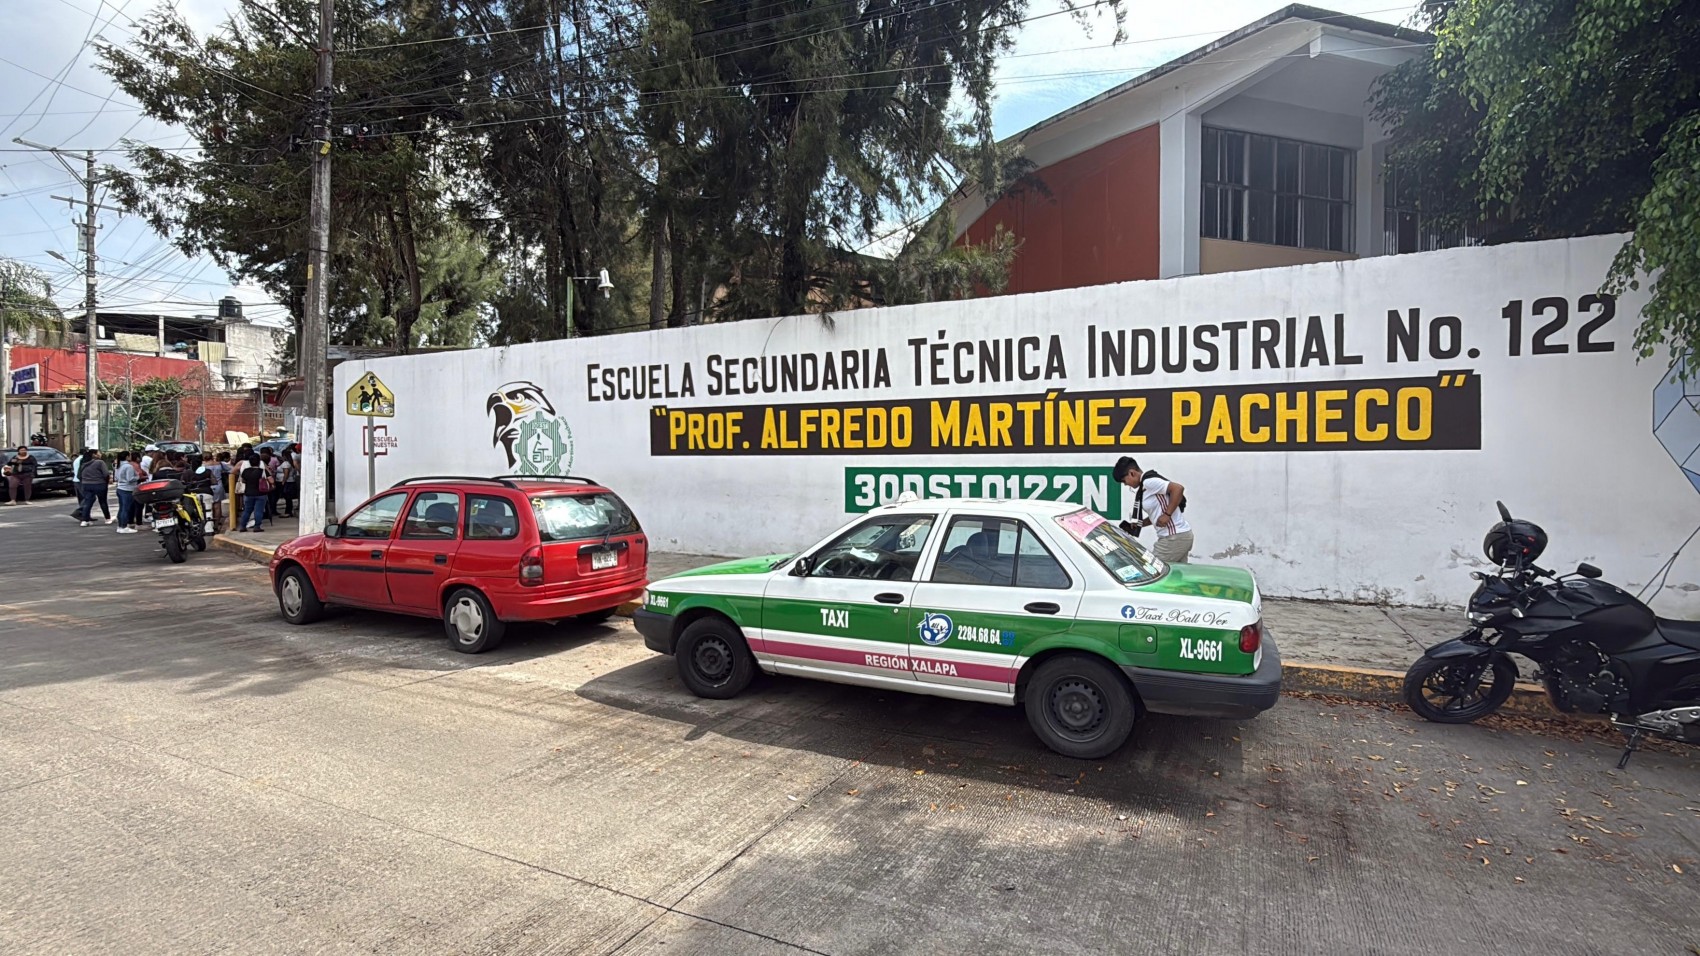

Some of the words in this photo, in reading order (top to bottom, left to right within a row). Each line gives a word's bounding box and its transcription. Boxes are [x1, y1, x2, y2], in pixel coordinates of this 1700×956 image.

[586, 362, 696, 402] ESCUELA
[706, 347, 892, 396] SECUNDARIA
[907, 329, 1068, 387] TÉCNICA
[1087, 313, 1364, 379] INDUSTRIAL
[1501, 293, 1617, 357] 122
[760, 405, 913, 449] ALFREDO
[930, 391, 1147, 448] MARTÍNEZ
[820, 608, 849, 628] TAXI
[1134, 606, 1164, 620] Taxi
[1203, 611, 1231, 626] Ver
[1179, 637, 1223, 662] XL-9661
[864, 655, 909, 670] REGIÓN
[911, 659, 958, 676] XALAPA
